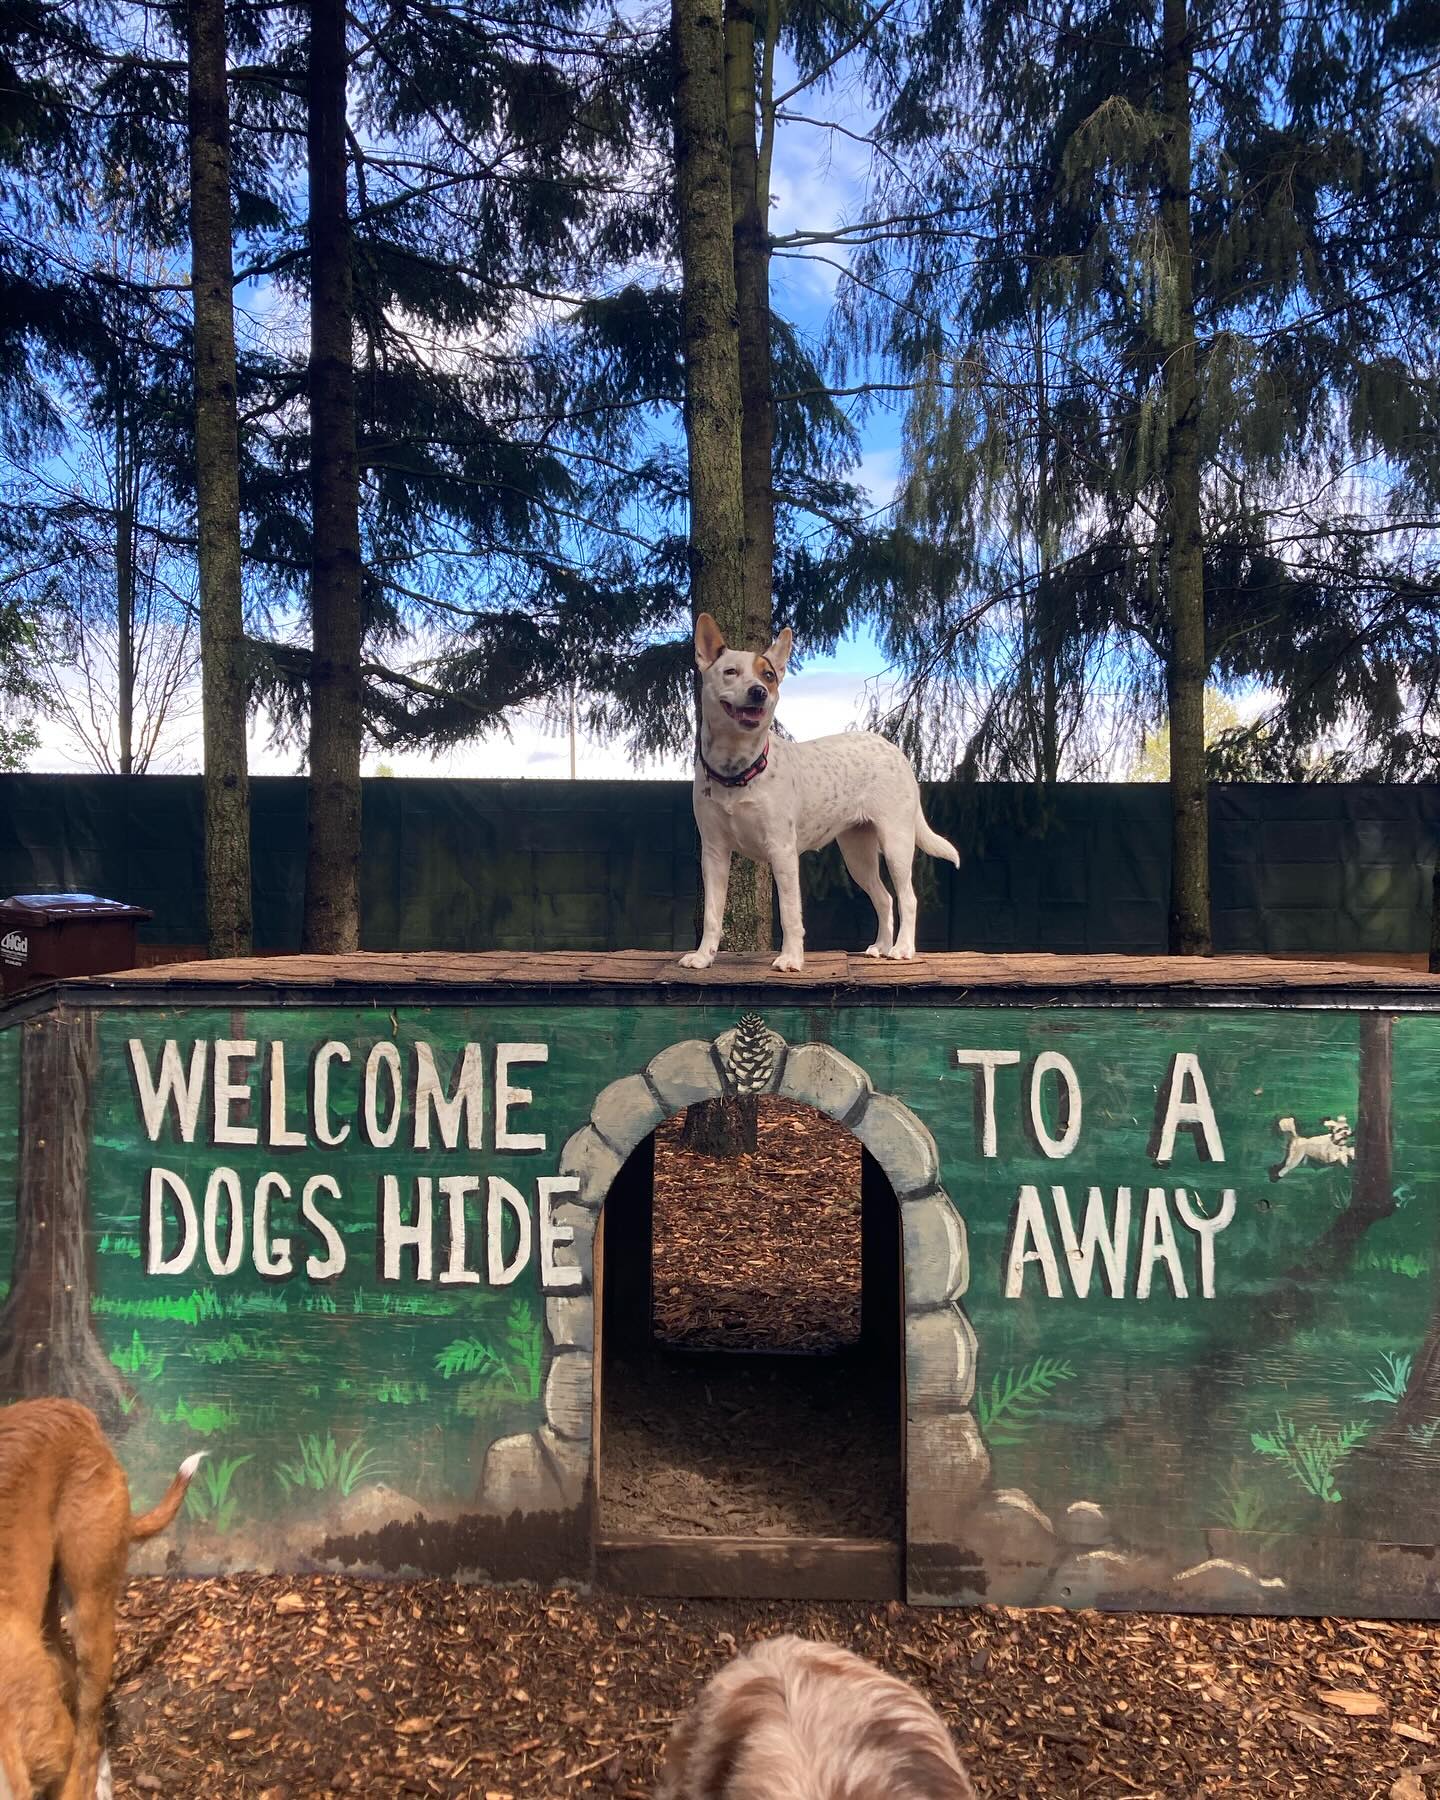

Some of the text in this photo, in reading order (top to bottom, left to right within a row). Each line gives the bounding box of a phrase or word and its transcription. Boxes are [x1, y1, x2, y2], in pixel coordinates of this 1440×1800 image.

[129, 1038, 1226, 1162] WELCOME TO A
[148, 1166, 1237, 1299] DOGS HIDE AWAY
